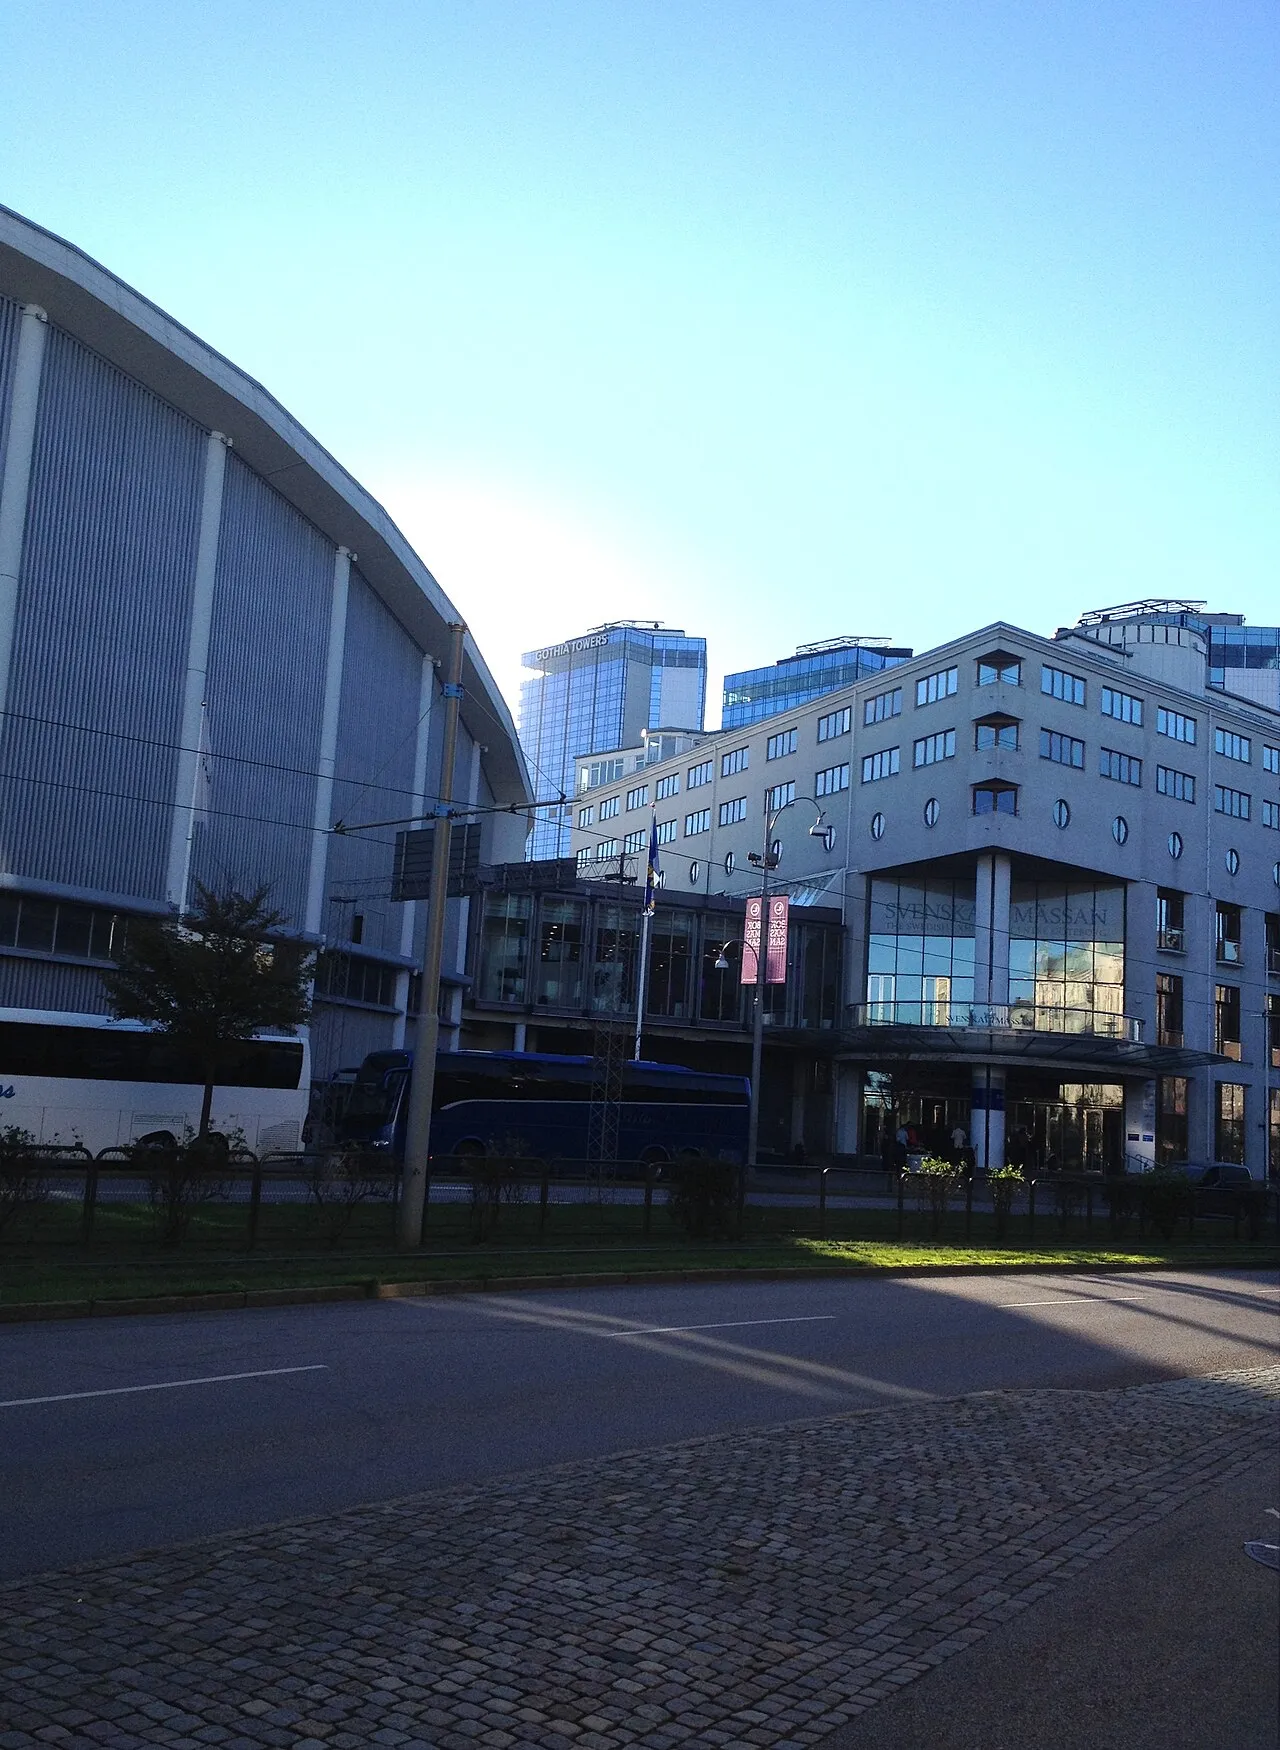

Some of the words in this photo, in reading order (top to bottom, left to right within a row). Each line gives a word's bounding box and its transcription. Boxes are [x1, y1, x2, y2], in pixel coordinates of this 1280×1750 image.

[536, 643, 570, 661] GOTHIA
[571, 634, 608, 652] TOWERS
[885, 902, 976, 921] SVENSKA
[1013, 903, 1108, 925] MÄSSAN
